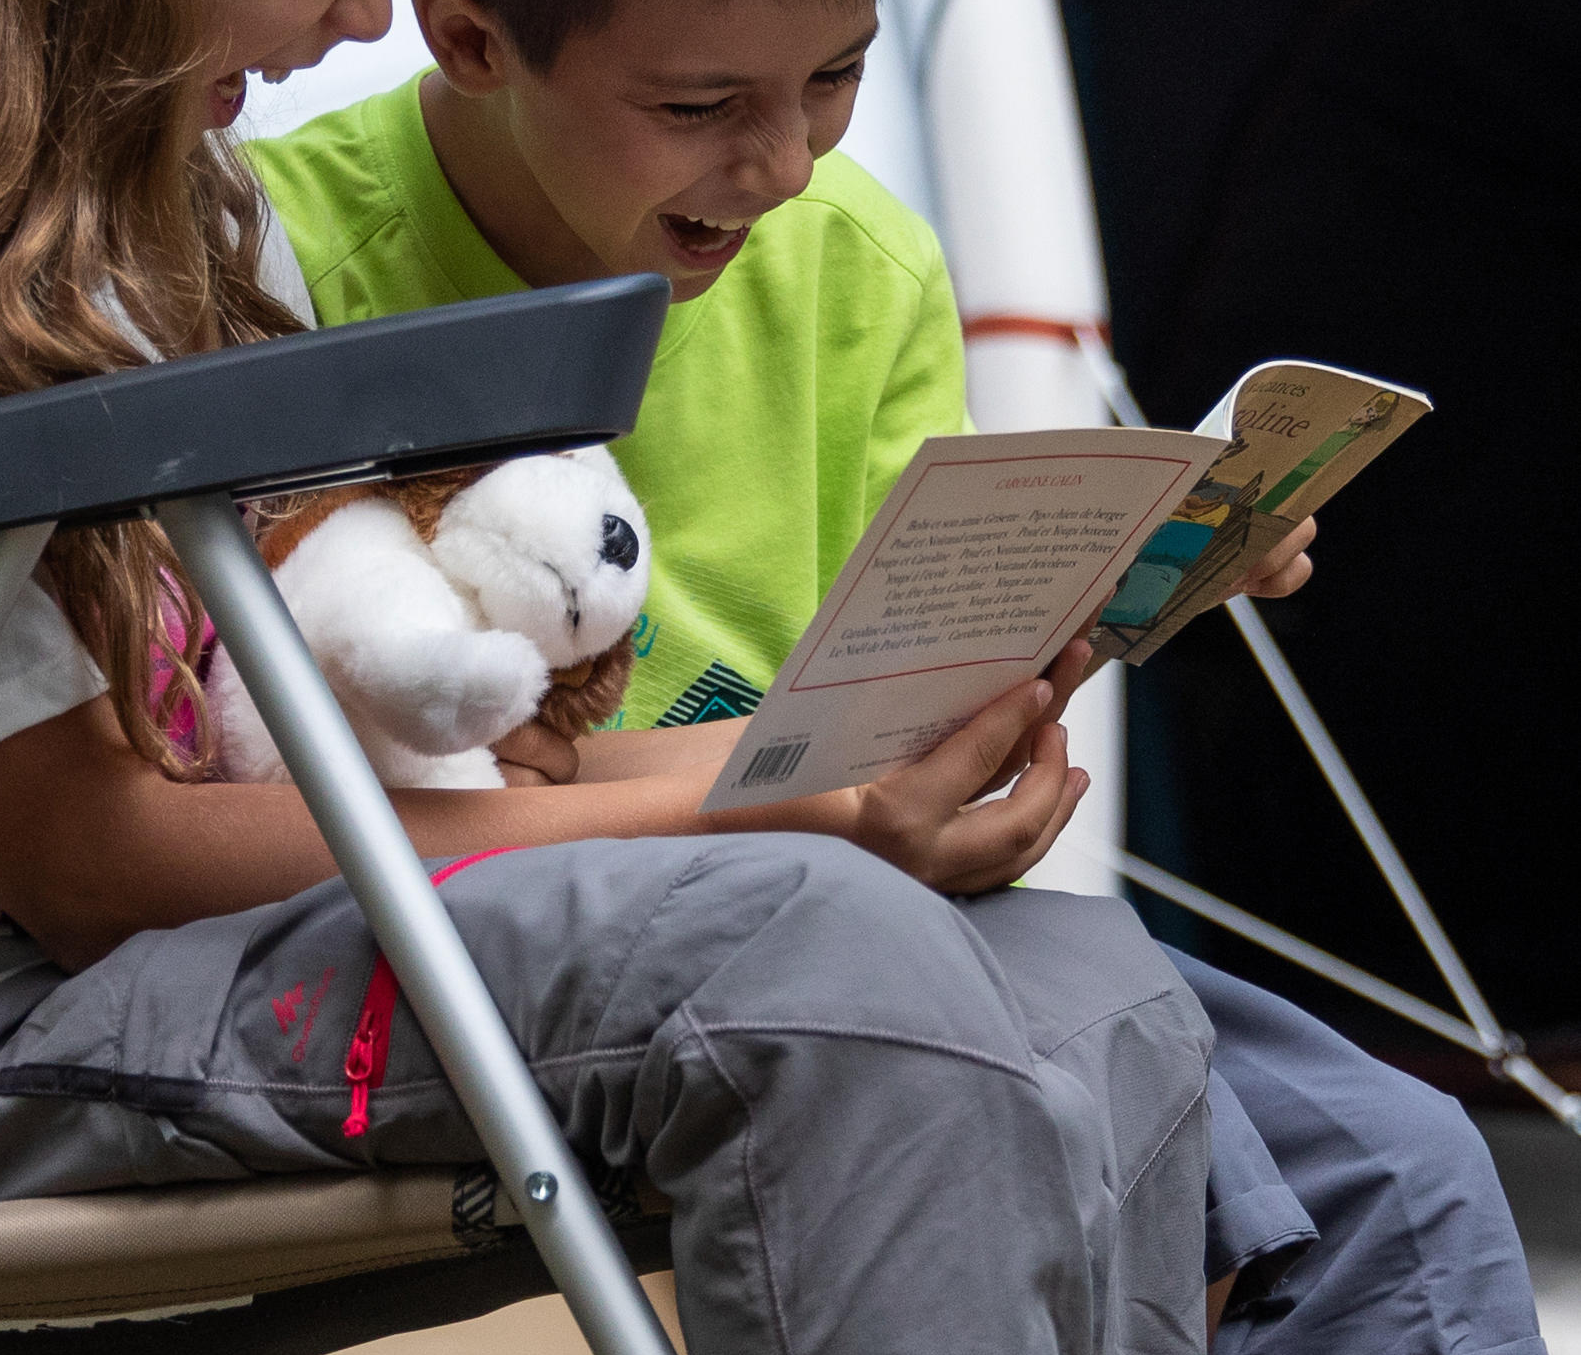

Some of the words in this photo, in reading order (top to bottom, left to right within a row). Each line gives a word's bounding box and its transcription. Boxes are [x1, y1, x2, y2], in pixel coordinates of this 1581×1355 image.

[1093, 508, 1128, 523] berger
[1079, 525, 1120, 537] boxeurs
[1080, 541, 1117, 554] d'hiver
[1009, 606, 1050, 618] Caroline
